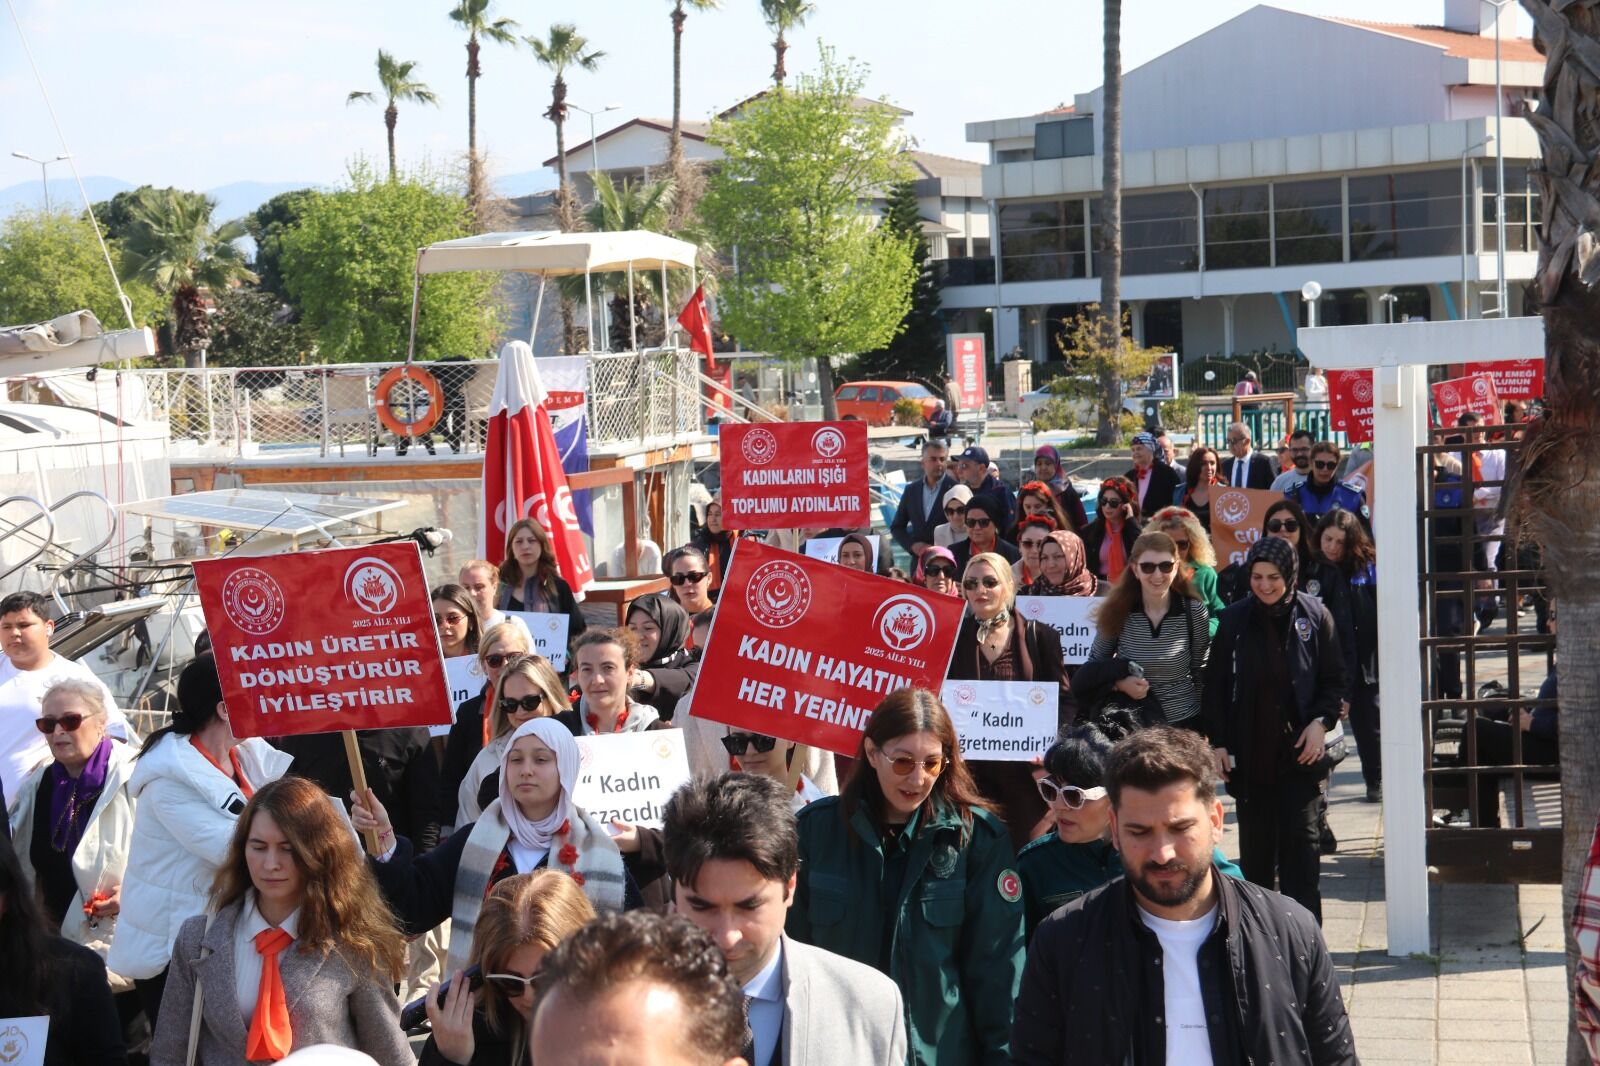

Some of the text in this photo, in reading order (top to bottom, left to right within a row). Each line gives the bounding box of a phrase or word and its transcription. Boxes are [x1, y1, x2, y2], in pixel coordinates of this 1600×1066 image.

[1493, 378, 1531, 386] LUMUN
[743, 464, 846, 488] KADINLARIN IŞIĞI
[731, 495, 860, 514] TOPLUMU AYDINLATIR
[352, 616, 412, 628] 2025 AİLE YILI
[1050, 622, 1089, 636] adın
[231, 630, 420, 662] KADIN ÜRETİR
[737, 634, 813, 674] KADIN
[864, 646, 926, 669] 2025 AİLE YILI
[239, 658, 422, 689] DÖNÜŞTÜRÜR
[259, 685, 414, 714] İYİLEŞTİRİR
[737, 677, 787, 711] HER
[982, 712, 1024, 727] Kadın
[600, 771, 661, 794] Kadın
